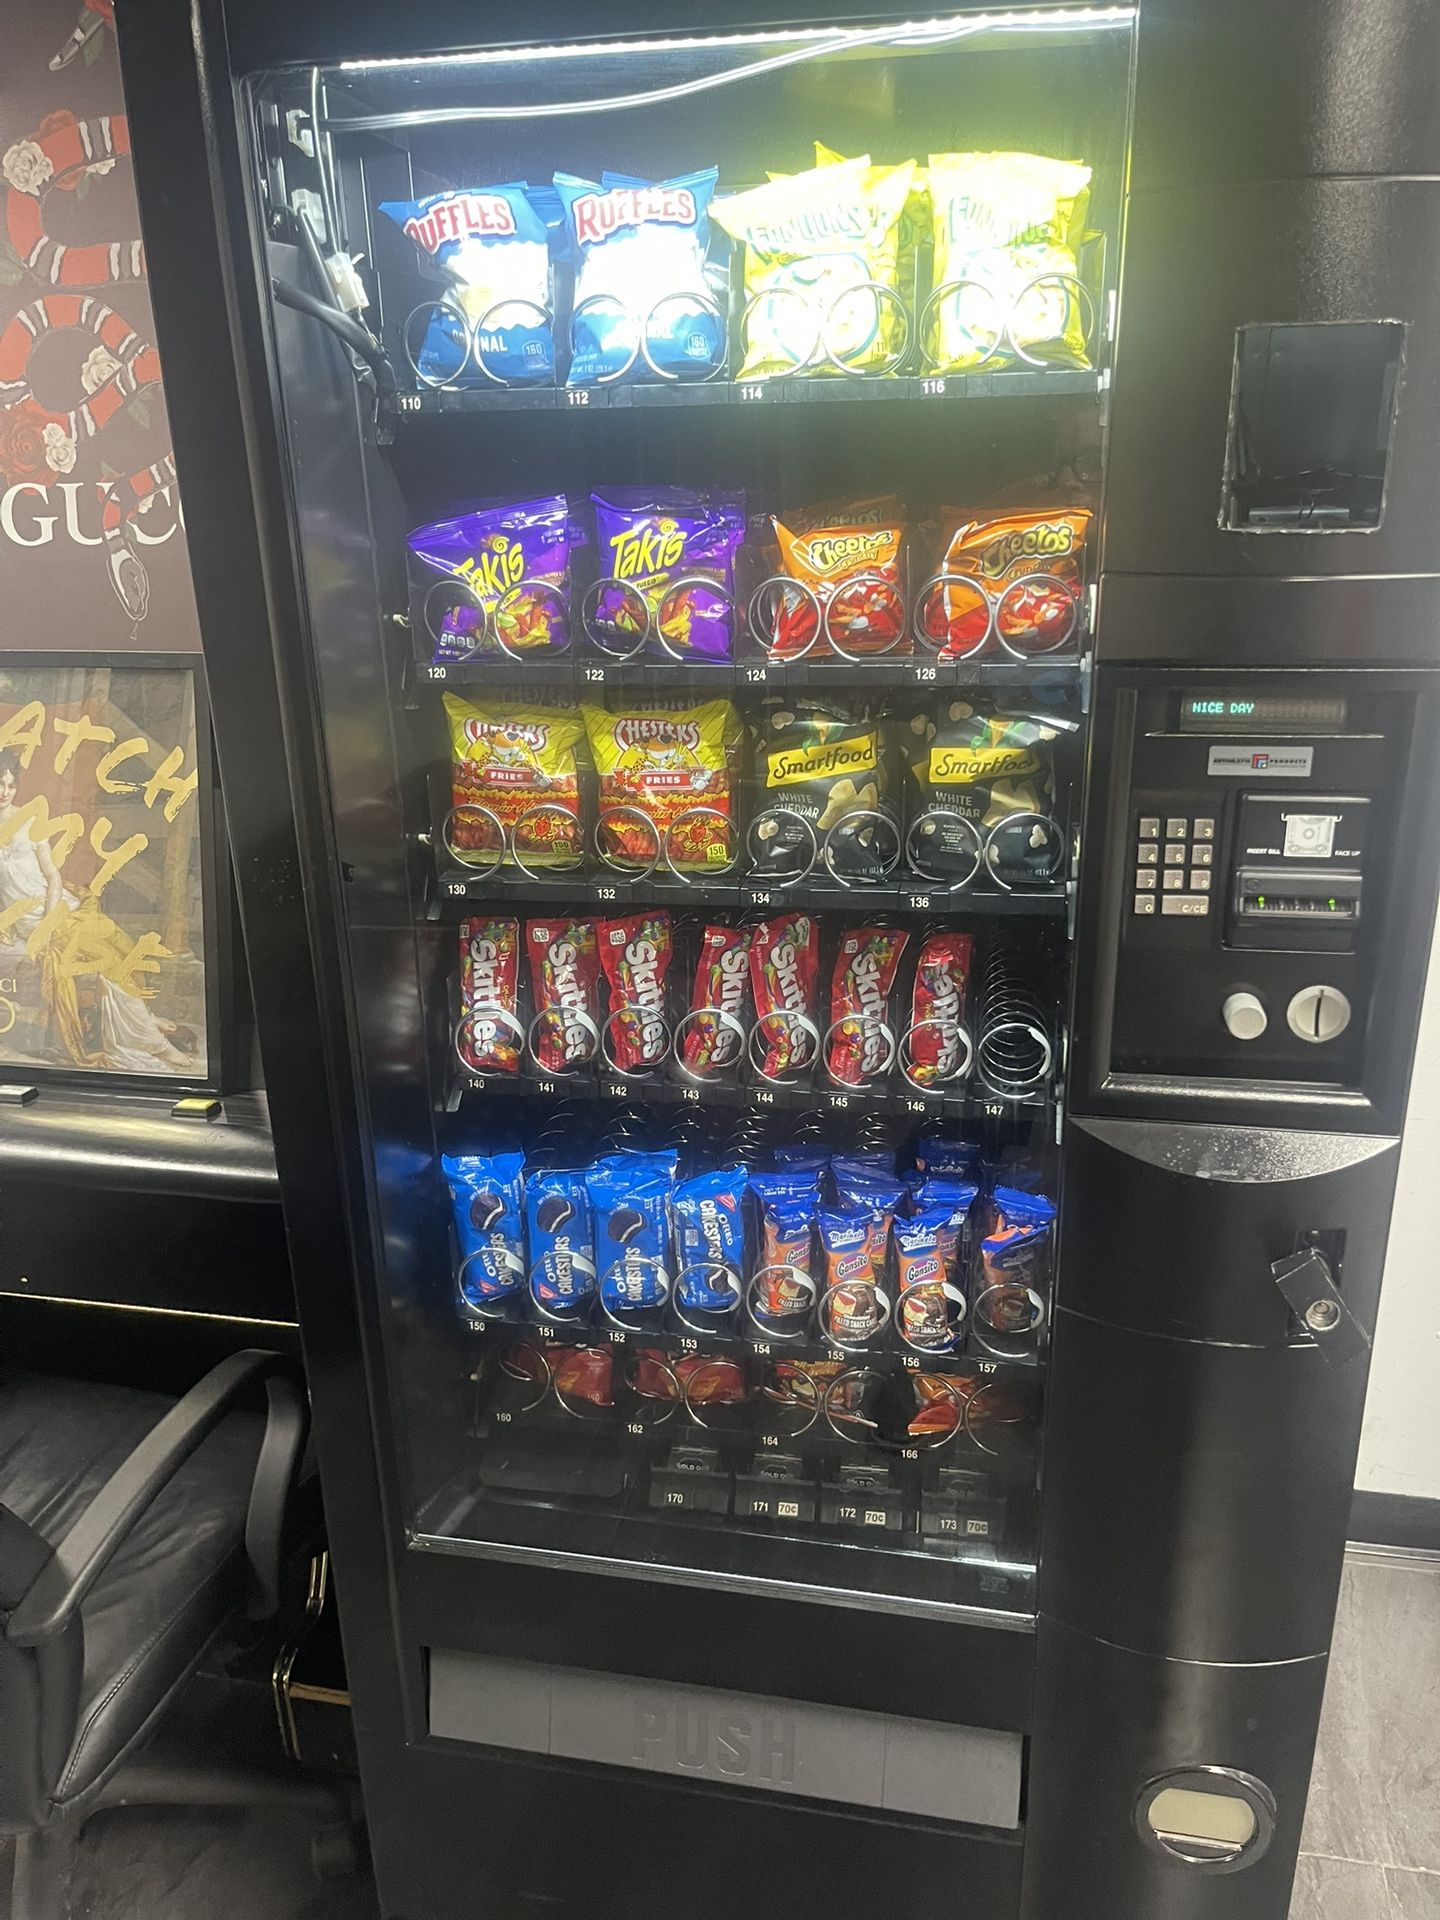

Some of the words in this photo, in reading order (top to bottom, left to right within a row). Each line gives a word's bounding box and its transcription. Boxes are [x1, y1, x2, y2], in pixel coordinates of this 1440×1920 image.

[576, 189, 693, 241] RUFFLES
[741, 387, 763, 400] 114
[922, 381, 945, 394] 116
[401, 397, 421, 411] 110
[567, 391, 589, 405] 112
[0, 482, 186, 547] GUC
[609, 519, 688, 579] Takis
[981, 524, 1073, 578] Cheetos
[452, 537, 525, 597] Takis
[428, 667, 447, 680] 120
[585, 669, 605, 681] 122
[746, 670, 767, 682] 124
[915, 668, 936, 681] 126
[1192, 701, 1224, 714] NICE
[1230, 702, 1255, 714] DAY
[773, 739, 874, 779] Smartfood
[490, 771, 524, 781] FRIES
[645, 775, 681, 786] FRIES
[777, 792, 814, 805] WHITE
[935, 791, 973, 806] WHITE
[773, 803, 820, 819] CHEDDAR
[928, 802, 981, 818] CHEDDAR
[553, 840, 570, 850] 150
[708, 846, 725, 857] 150
[448, 884, 466, 896] 130
[597, 888, 616, 900] 132
[751, 892, 770, 905] 134
[909, 896, 930, 908] 136
[1182, 904, 1208, 914] C/CE
[625, 940, 665, 1059] Skittles
[711, 950, 749, 1062] Skites
[468, 1078, 486, 1089] 140
[538, 1082, 555, 1093] 141
[609, 1086, 627, 1097] 142
[682, 1089, 700, 1100] 143
[756, 1092, 774, 1104] 144
[829, 1096, 848, 1108] 145
[906, 1100, 925, 1112] 146
[984, 1104, 1004, 1116] 147
[718, 1212, 733, 1246] OREO
[900, 1232, 937, 1247] Marinela
[481, 1249, 497, 1277] ORE
[490, 1232, 515, 1286] CAKESRS
[837, 1254, 869, 1277] Gansito
[908, 1259, 939, 1282] Gansito
[469, 1321, 486, 1332] 150
[834, 1315, 850, 1327] FILLED
[850, 1319, 867, 1328] SNACK
[538, 1327, 554, 1338] 151
[920, 1326, 937, 1335] SNACK
[608, 1332, 626, 1343] 152
[680, 1338, 698, 1349] 153
[753, 1344, 771, 1355] 154
[827, 1350, 845, 1361] 155
[901, 1356, 920, 1368] 156
[978, 1362, 997, 1374] 157
[496, 1412, 512, 1423] 160
[627, 1424, 644, 1434] 162
[762, 1435, 779, 1446] 164
[901, 1449, 919, 1460] 166
[667, 1493, 684, 1504] 170
[753, 1501, 769, 1513] 171
[839, 1507, 857, 1519] 172
[939, 1519, 957, 1530] 173
[631, 1705, 799, 1785] PUSH
